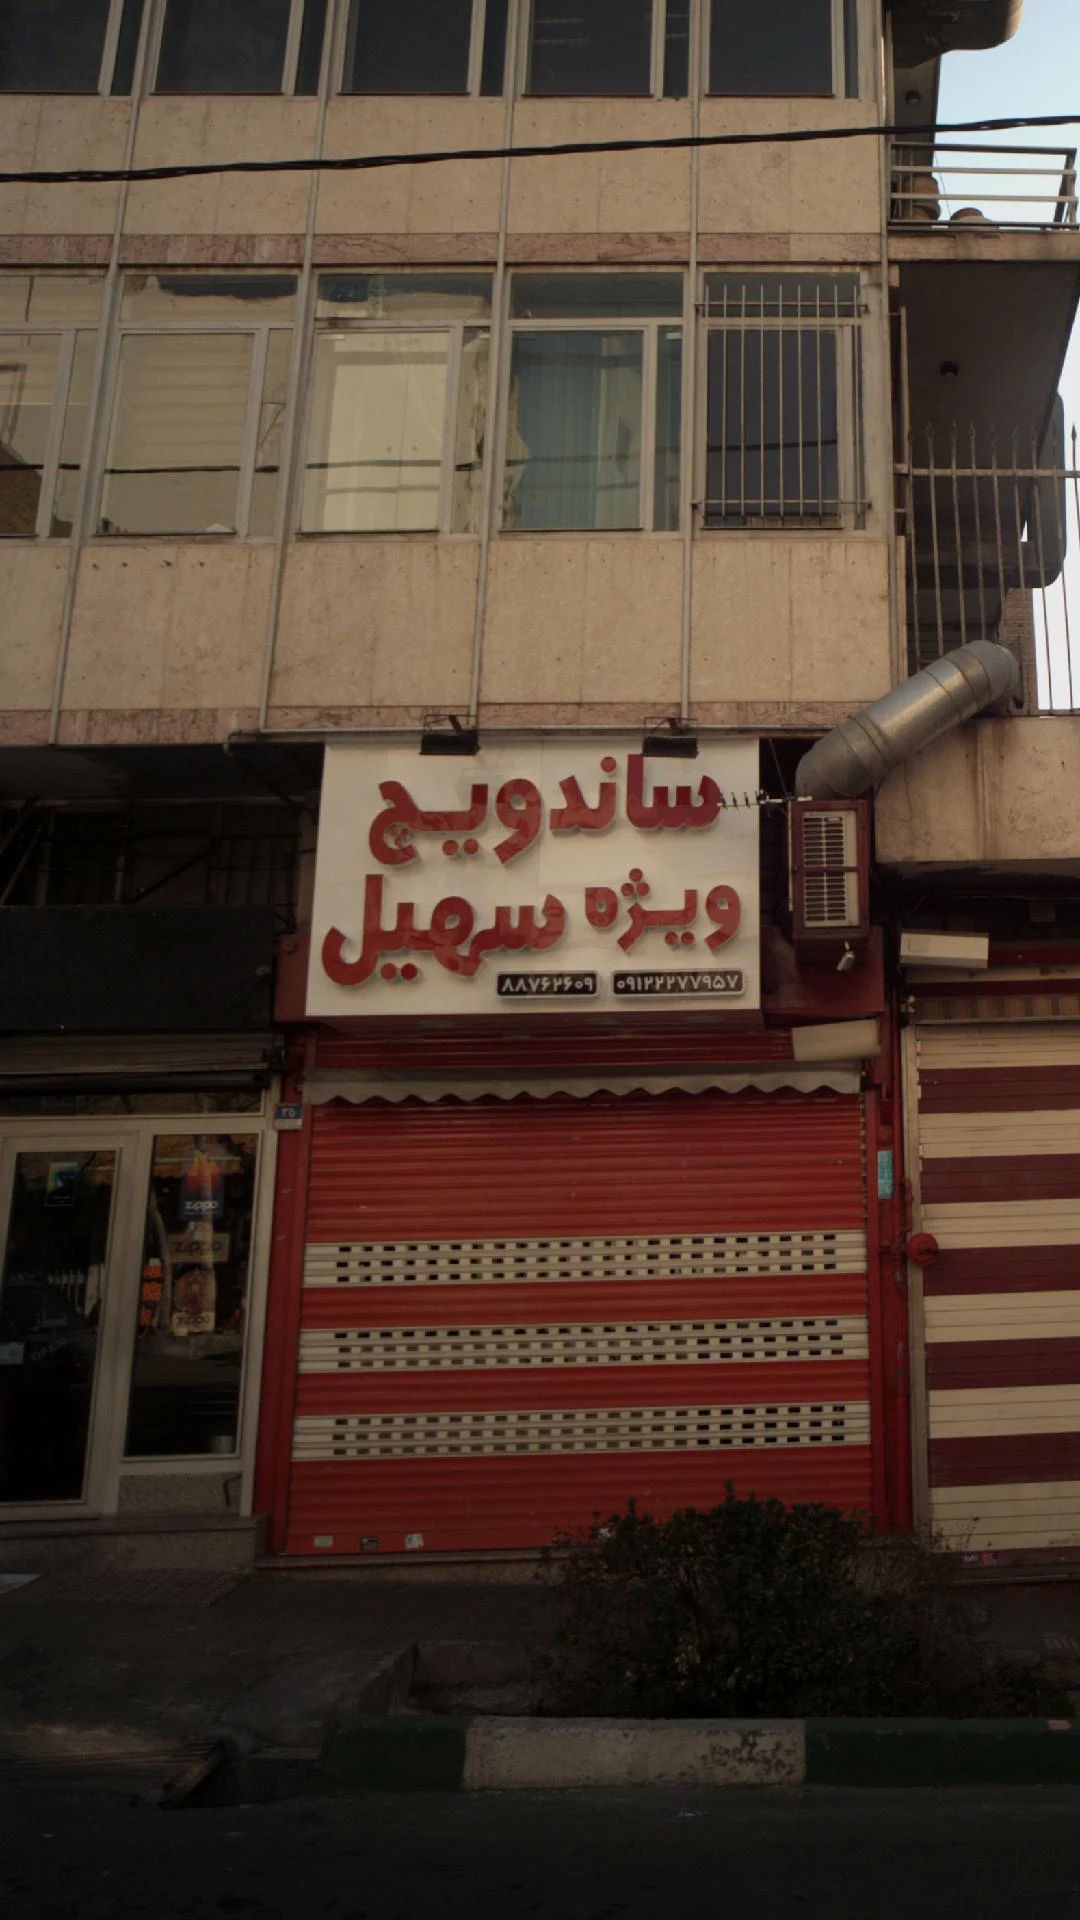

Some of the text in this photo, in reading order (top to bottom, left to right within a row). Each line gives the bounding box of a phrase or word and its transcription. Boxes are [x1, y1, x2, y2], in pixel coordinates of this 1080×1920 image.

[369, 753, 722, 865] ساندویچ
[322, 869, 741, 987] ویژه سهیل
